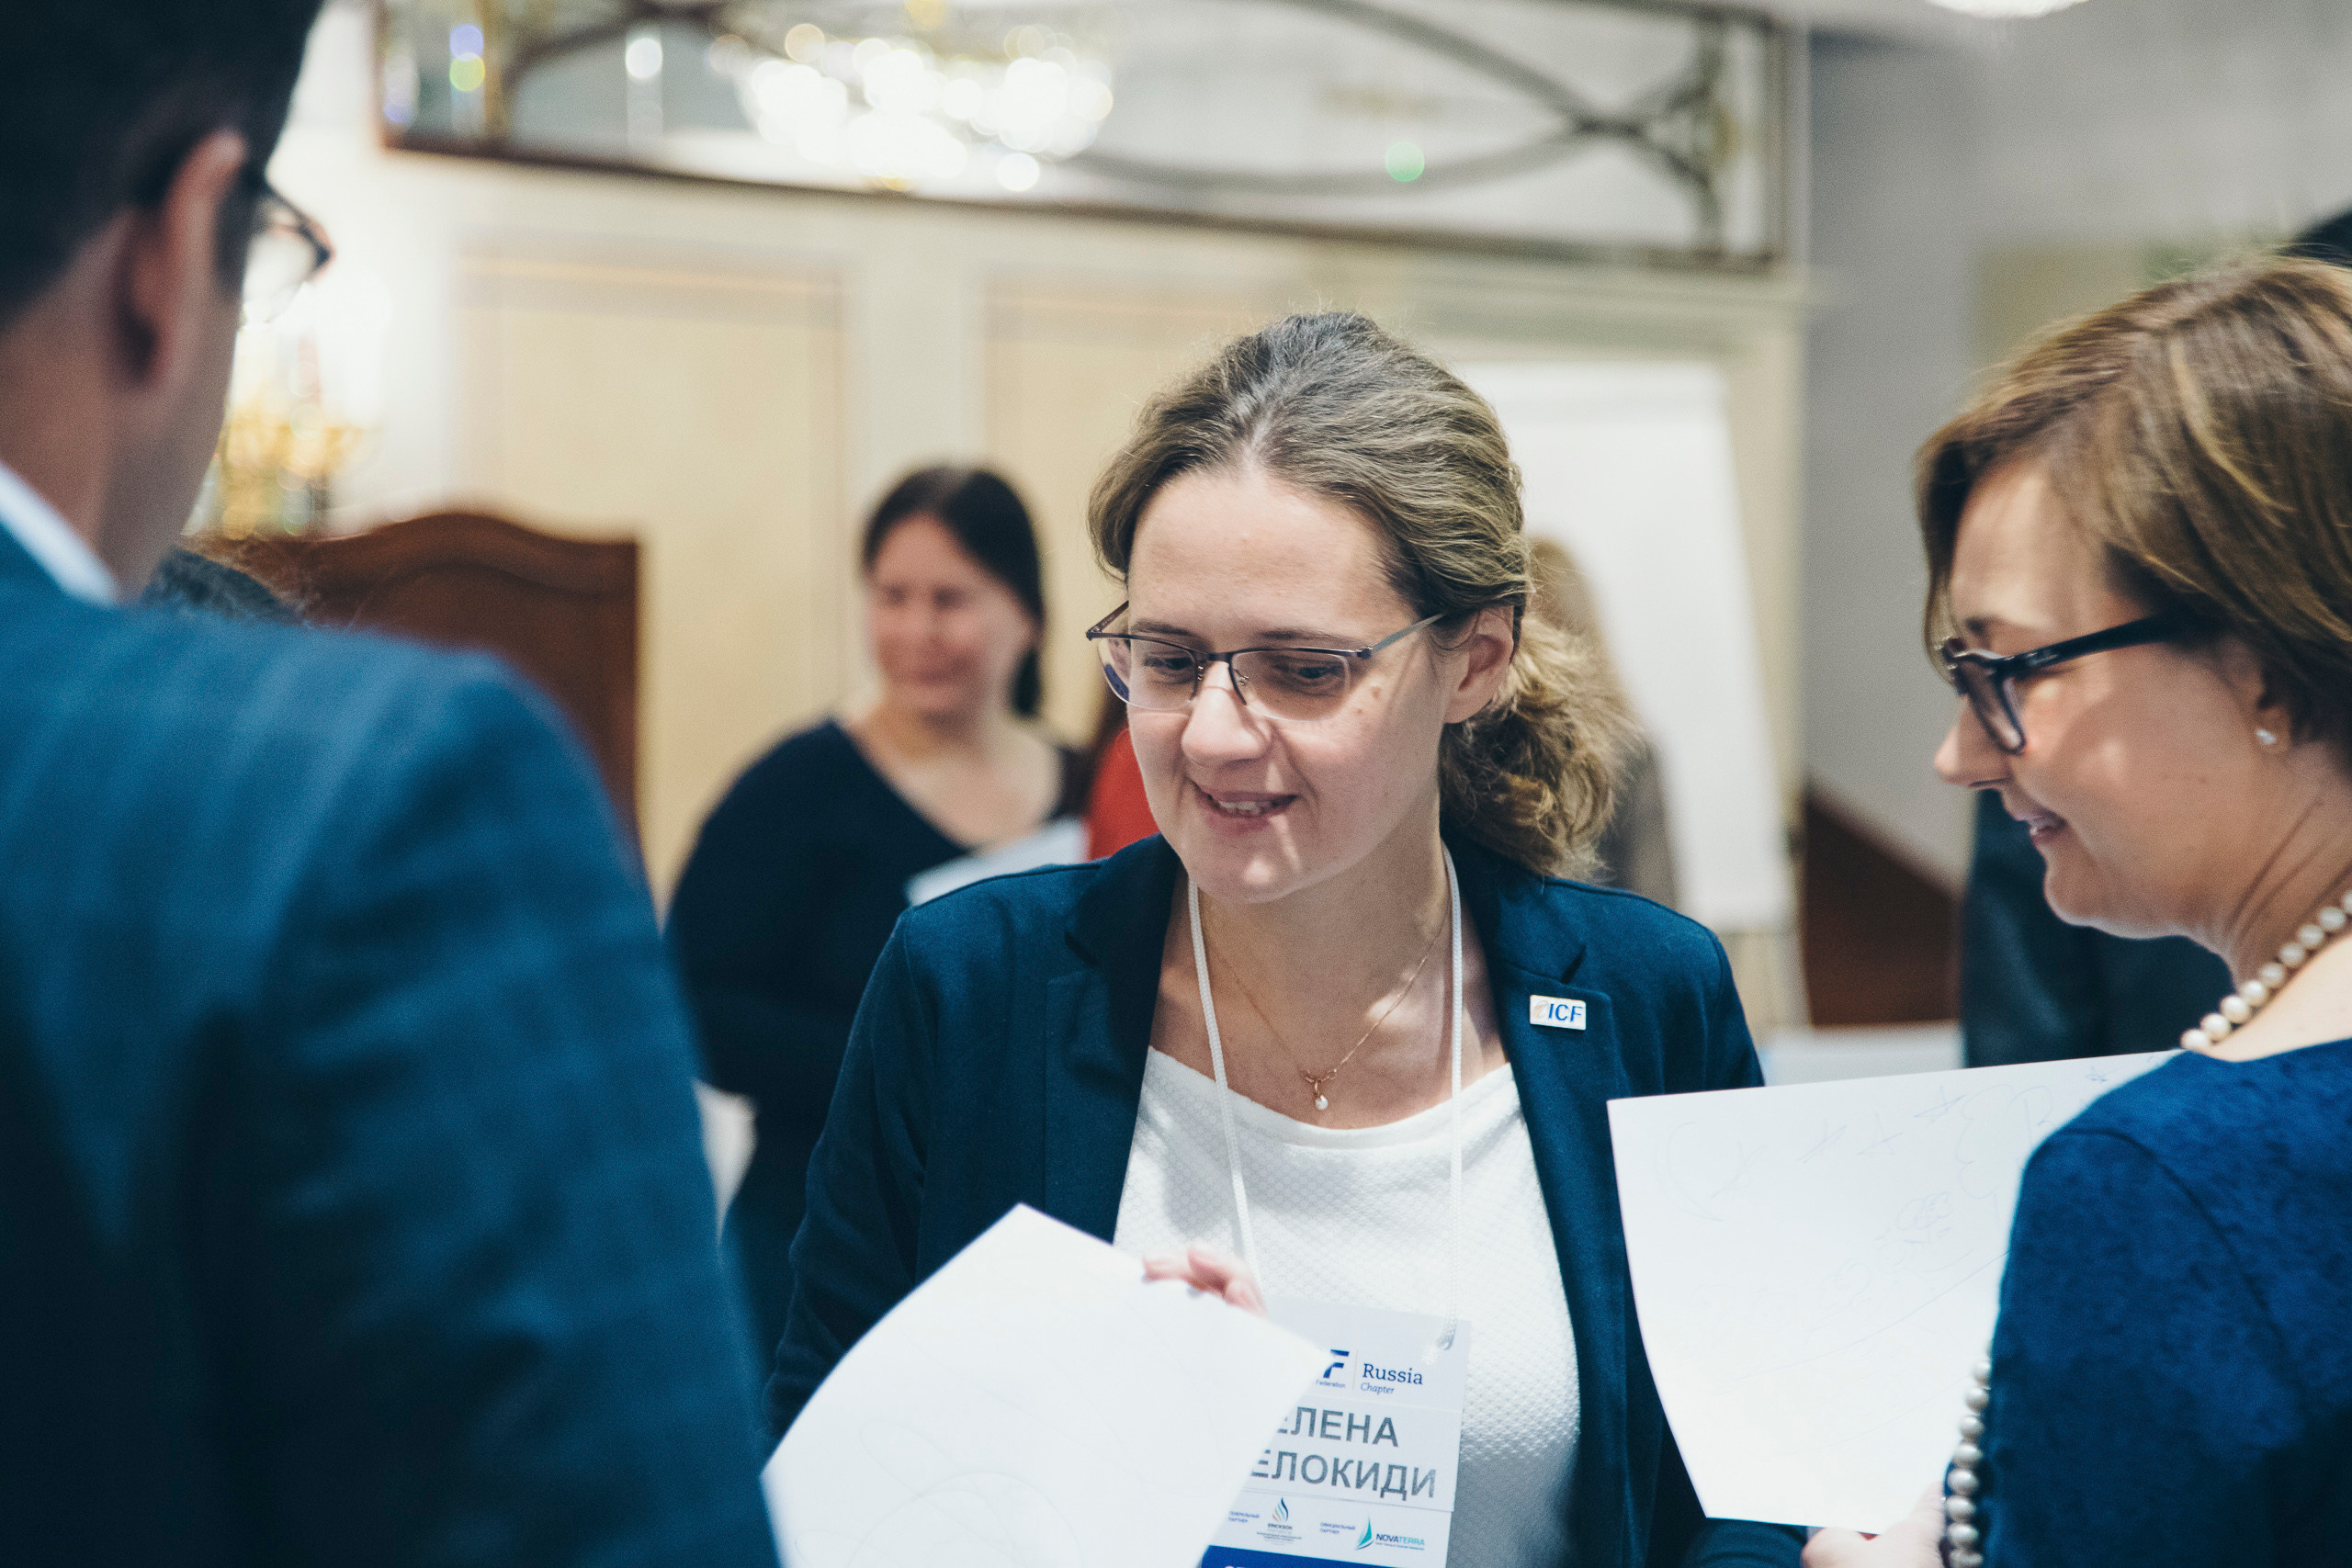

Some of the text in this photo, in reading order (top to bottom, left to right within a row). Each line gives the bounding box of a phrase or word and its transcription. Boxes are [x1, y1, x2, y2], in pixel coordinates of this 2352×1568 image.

[1548, 1003, 1584, 1021] ICF
[1363, 1362, 1423, 1384] Russia
[1360, 1382, 1395, 1395] Chapter
[1375, 1533, 1425, 1546] NOVATERRA
